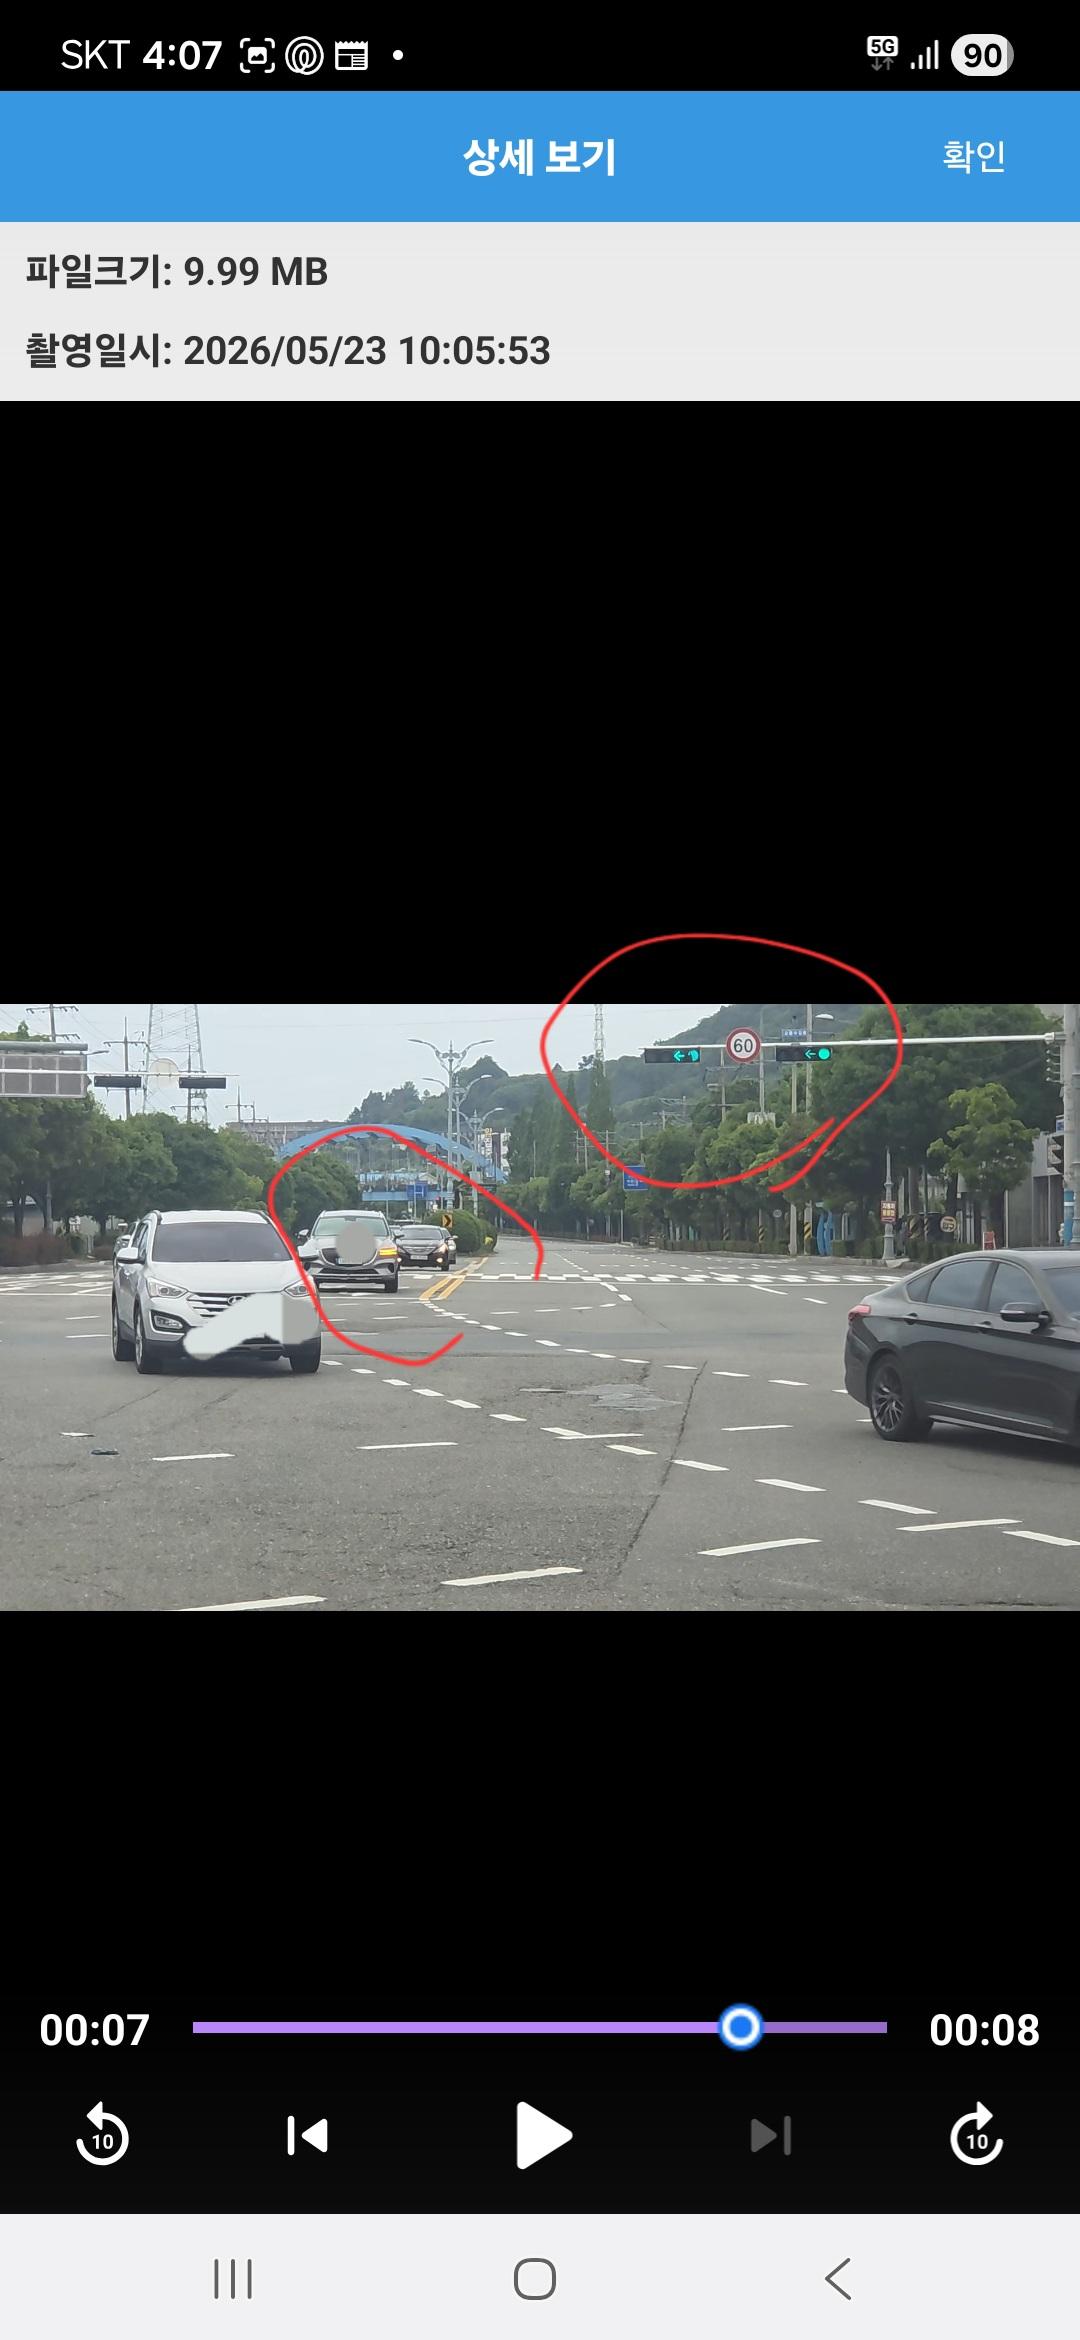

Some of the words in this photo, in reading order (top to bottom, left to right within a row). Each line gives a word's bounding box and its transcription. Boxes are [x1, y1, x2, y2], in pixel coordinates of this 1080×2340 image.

[61, 41, 130, 70] SKT
[143, 40, 222, 70] 4:07
[871, 39, 895, 54] 5G
[964, 43, 1003, 68] 90
[463, 139, 533, 176] 상세
[546, 139, 615, 176] 보기
[943, 141, 1005, 174] 확인
[26, 253, 172, 289] 파일크기:
[184, 256, 260, 288] 9.99
[271, 256, 328, 288] MB
[26, 332, 172, 369] 촬영일시:
[183, 334, 386, 369] 2026/05/23
[399, 335, 551, 366] 10:05:53
[734, 1039, 753, 1053] 60
[40, 2013, 150, 2047] 00:07
[930, 2013, 1040, 2047] 00:08
[91, 2134, 114, 2150] 10
[966, 2134, 989, 2150] 10
